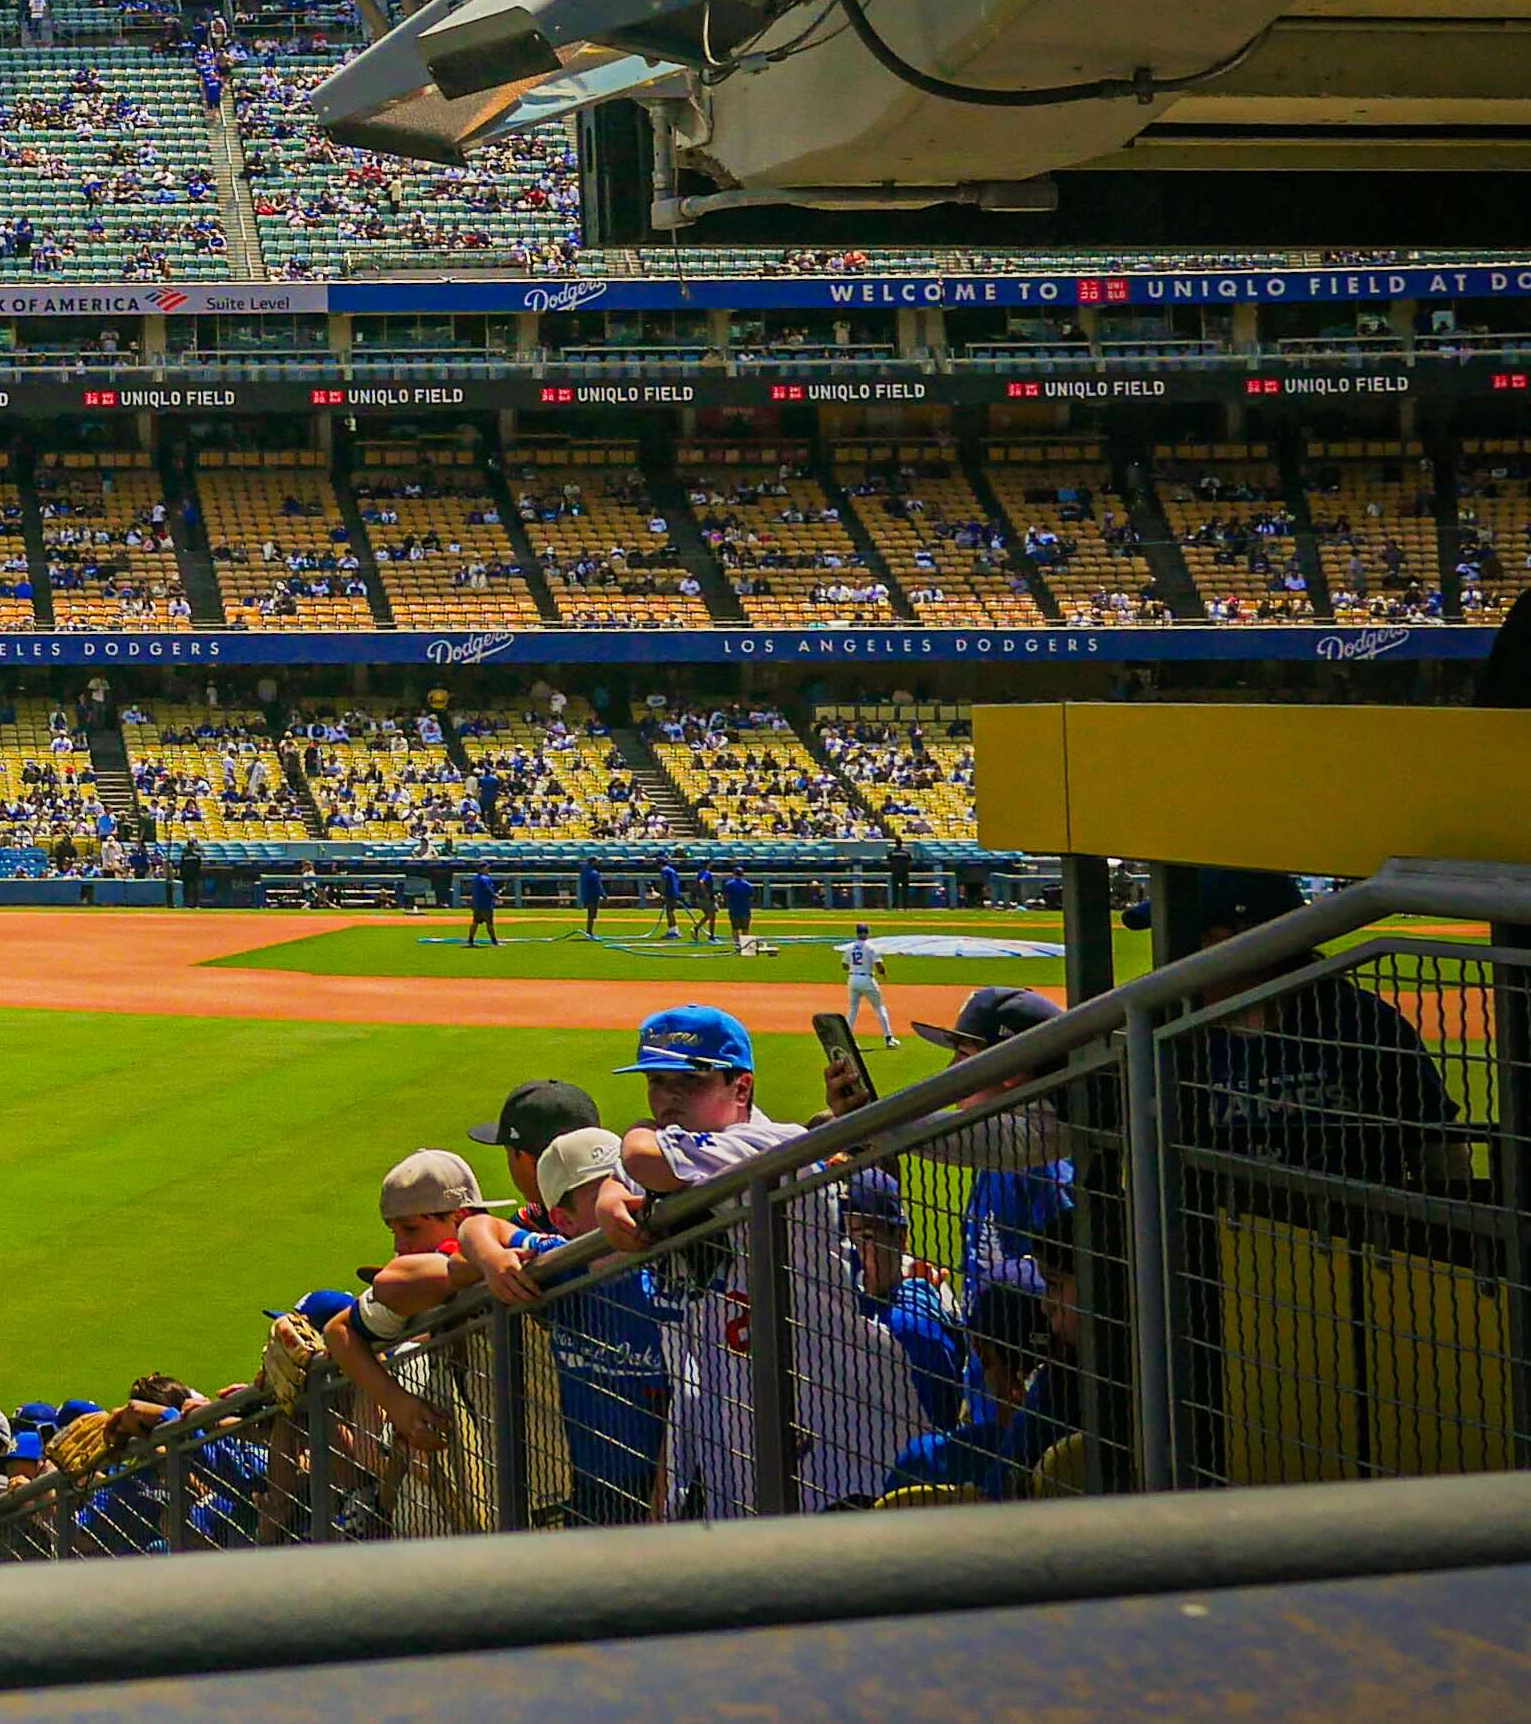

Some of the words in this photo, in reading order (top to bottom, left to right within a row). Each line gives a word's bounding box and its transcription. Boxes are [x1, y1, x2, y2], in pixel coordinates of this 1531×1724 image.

[830, 283, 996, 302] WELCOME
[1018, 283, 1058, 300] TO
[1148, 279, 1285, 298] UNIQLO
[1310, 276, 1405, 295] FIELD
[1430, 275, 1466, 292] AT
[12, 298, 40, 312] OF
[43, 296, 141, 312] AMERICA
[205, 295, 246, 310] Suite
[250, 295, 290, 310] Level
[524, 281, 608, 312] Dodgers
[808, 385, 870, 401] UNIQLO
[875, 384, 925, 398] FIELD
[1045, 383, 1108, 399] UNIQLO
[1113, 381, 1165, 396] FIELD
[1285, 379, 1349, 395] UNIQLO
[1356, 377, 1408, 392] FIELD
[120, 391, 181, 407] UNIQLO
[186, 391, 235, 405] FIELD
[348, 389, 409, 405] UNIQLO
[414, 389, 463, 403] FIELD
[577, 387, 638, 403] UNIQLO
[644, 387, 693, 401] FIELD
[84, 642, 219, 656] DODGERS
[426, 632, 514, 663] Dodgers
[724, 639, 773, 653] LOS
[798, 639, 931, 653] ANGELES
[956, 638, 1097, 652] DODGERS
[1317, 628, 1410, 659] Dodgers
[851, 951, 863, 966] 12
